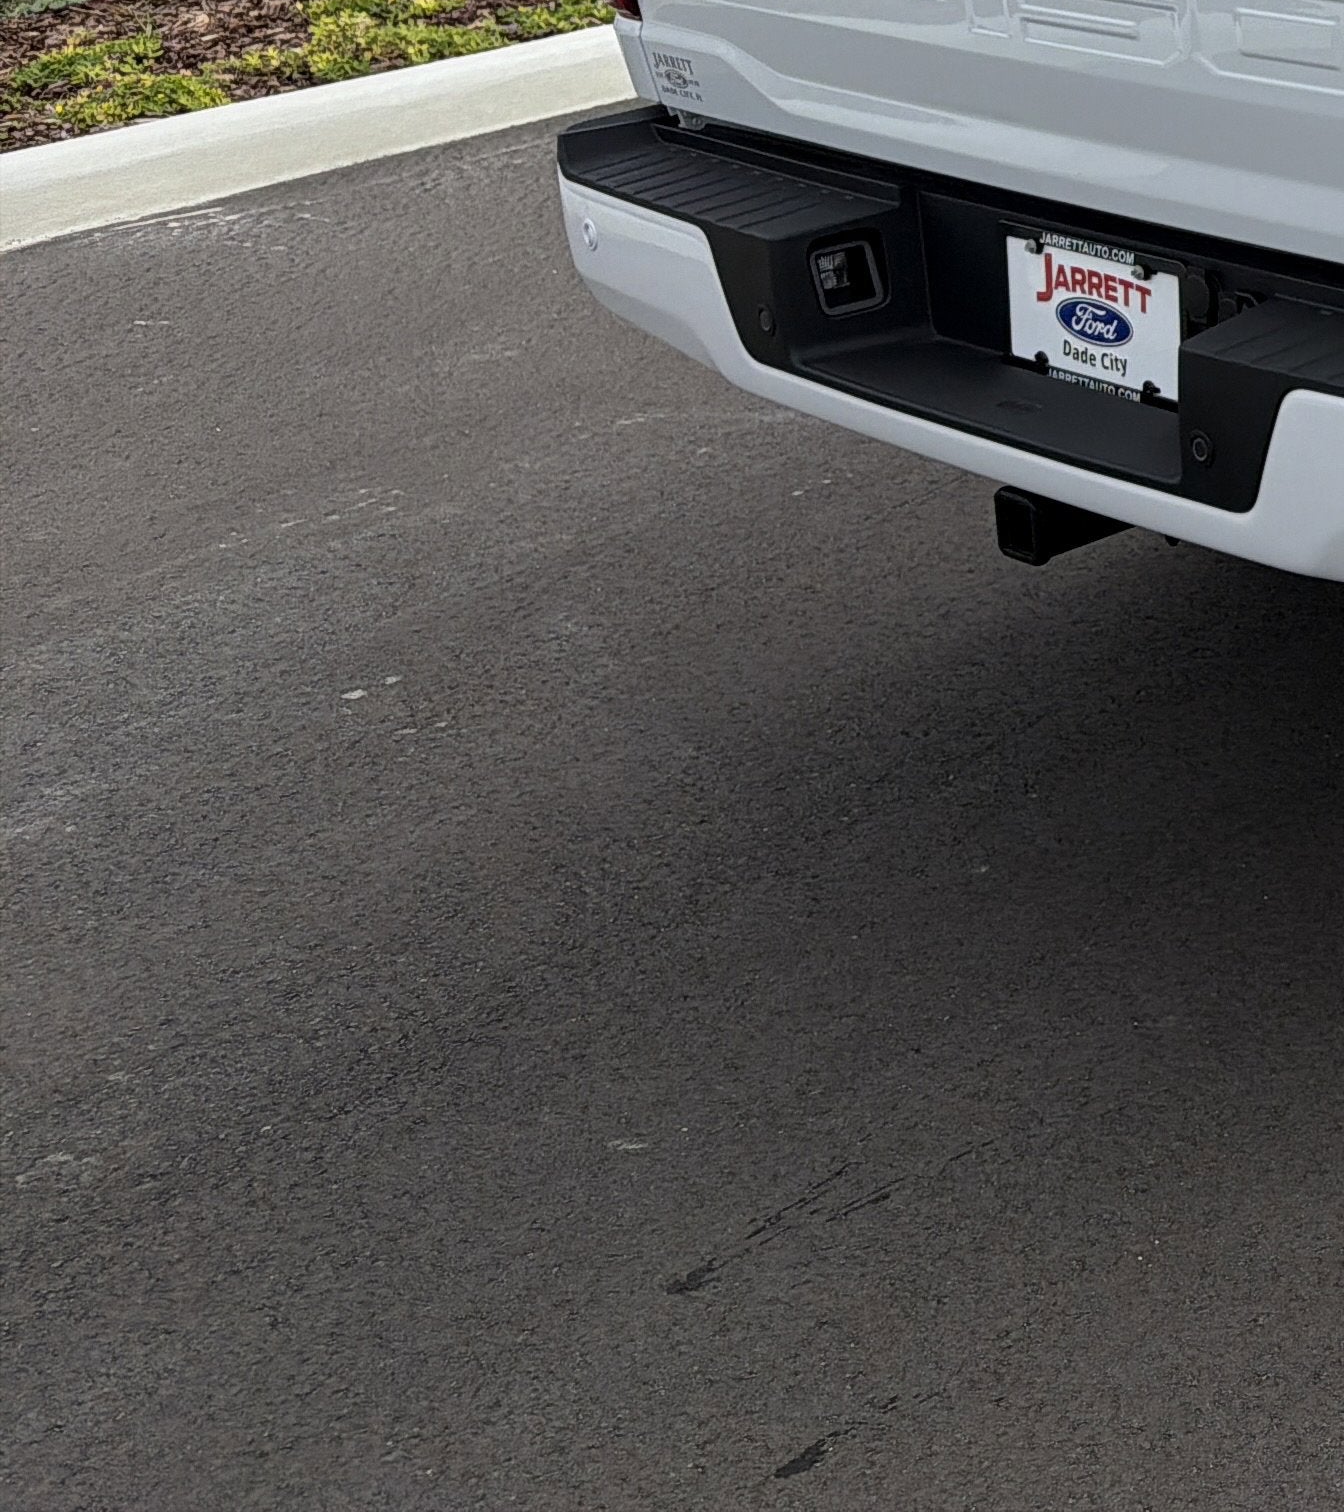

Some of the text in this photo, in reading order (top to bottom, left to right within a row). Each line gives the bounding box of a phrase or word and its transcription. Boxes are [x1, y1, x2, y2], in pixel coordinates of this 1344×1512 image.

[1040, 232, 1135, 265] JARRETTAUTO.COM
[1037, 253, 1152, 313] JARRETT
[1072, 303, 1118, 340] Ford
[1063, 339, 1128, 377] Dade City
[1048, 368, 1141, 403] JARRETTAUTOCOM
